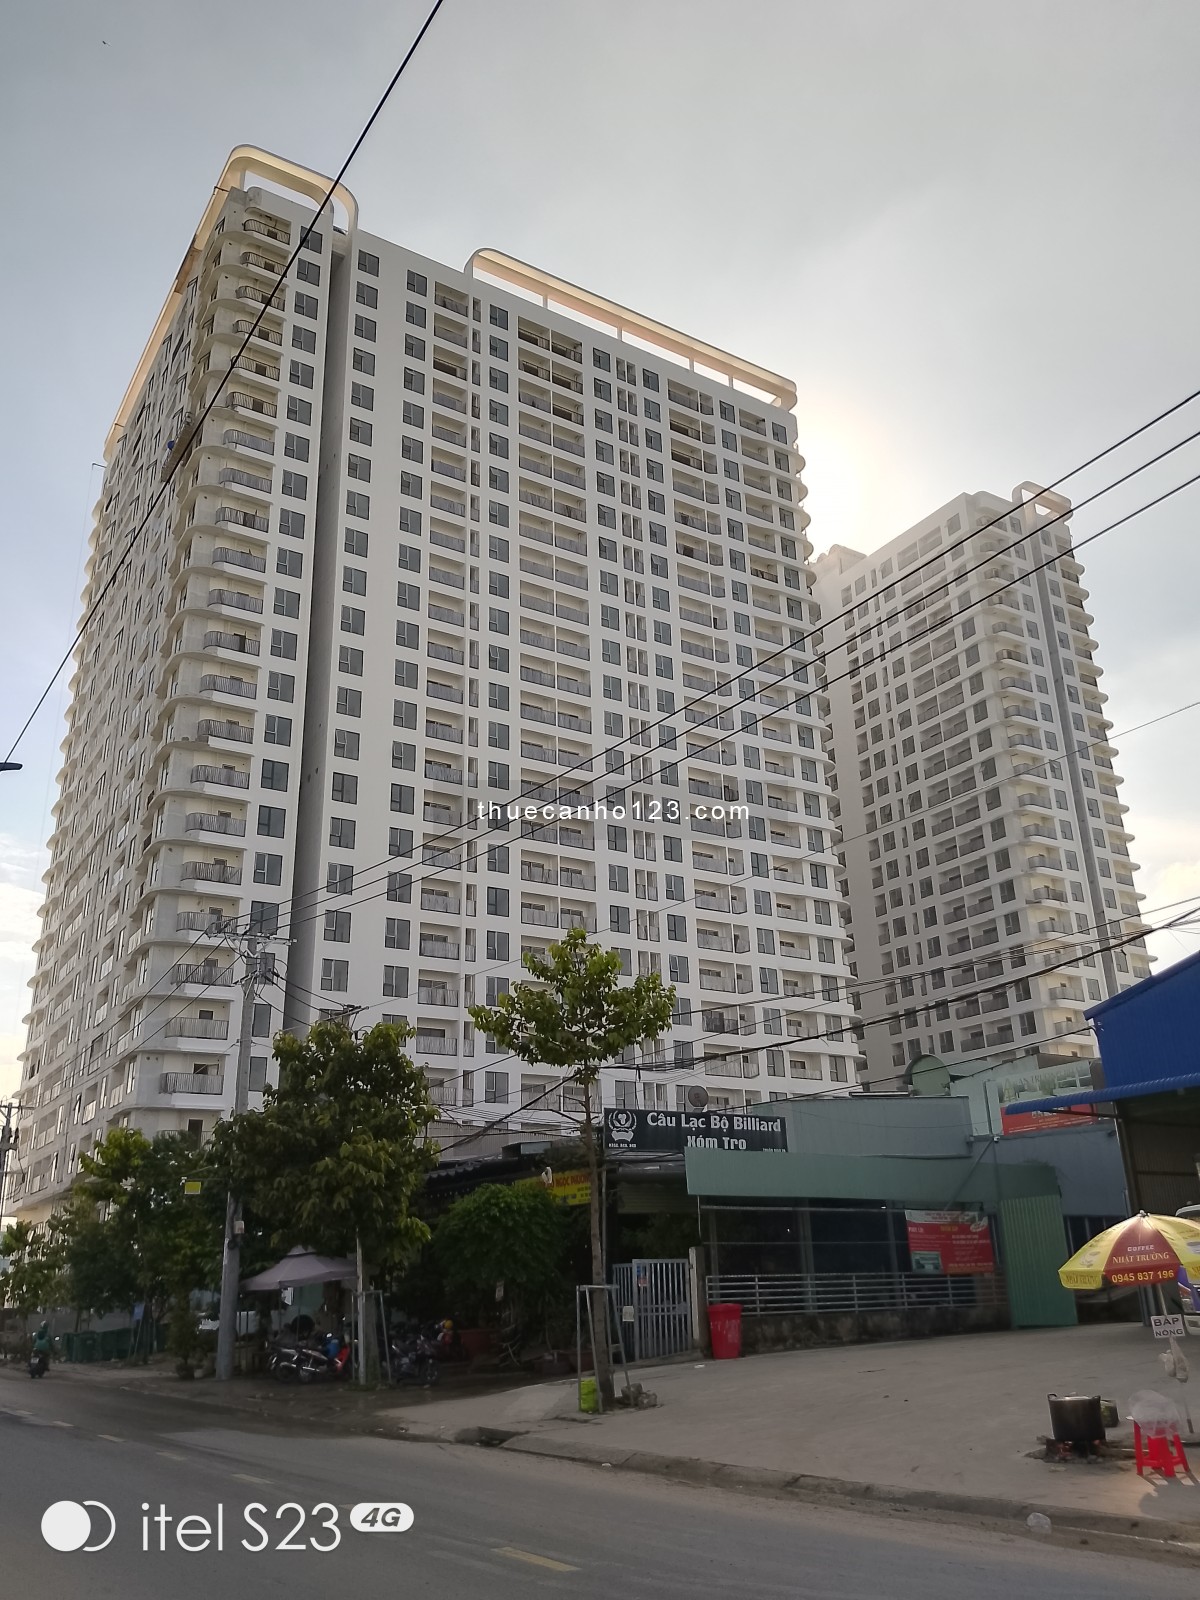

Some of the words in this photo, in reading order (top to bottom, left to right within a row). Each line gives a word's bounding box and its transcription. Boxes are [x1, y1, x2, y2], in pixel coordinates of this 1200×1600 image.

[646, 1112, 676, 1127] Câu
[681, 1113, 706, 1132] Lạc
[710, 1115, 729, 1133] Bộ
[733, 1116, 781, 1132] Billiard
[1111, 1272, 1135, 1283] 0945
[1137, 1271, 1154, 1281] 837
[1157, 1269, 1174, 1279] 196
